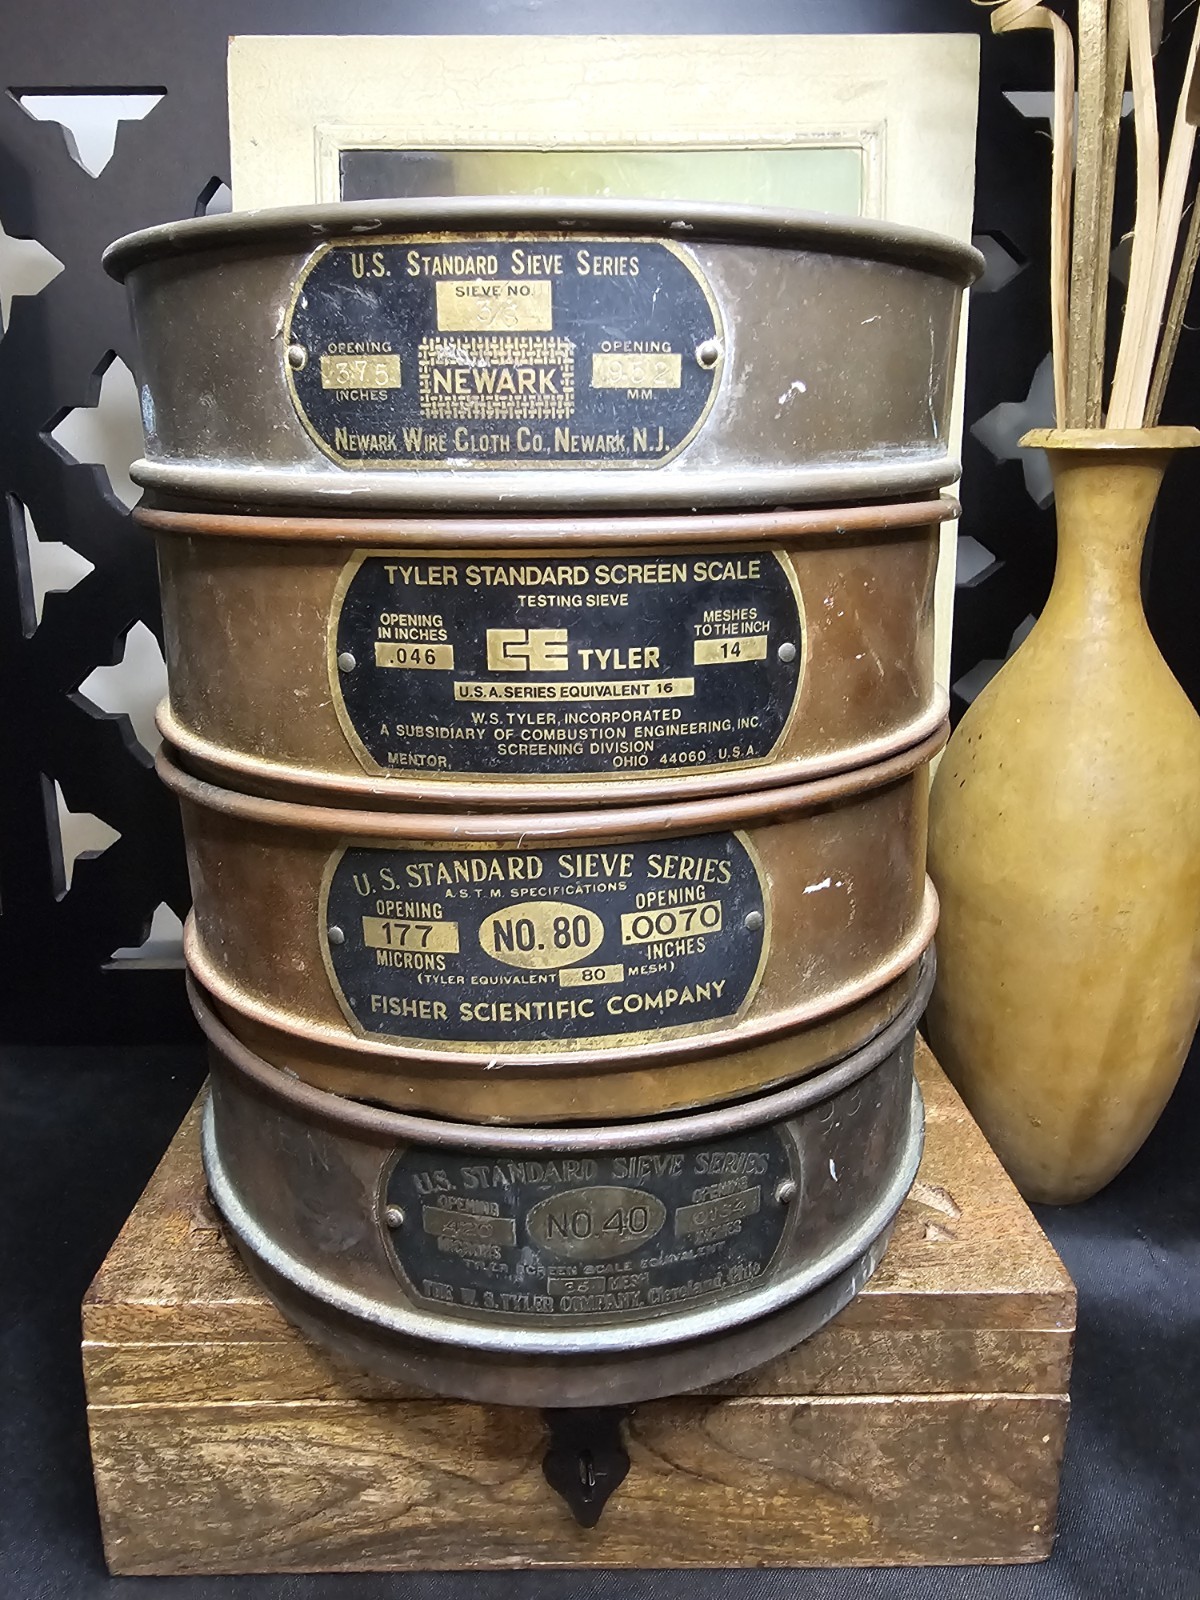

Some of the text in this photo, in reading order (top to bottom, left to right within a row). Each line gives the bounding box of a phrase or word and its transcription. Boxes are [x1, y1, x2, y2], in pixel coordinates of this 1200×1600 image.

[352, 249, 639, 278] U.S. STANDARD SIEVE SERIES
[455, 286, 501, 297] SIEVE
[327, 342, 392, 353] OPENING
[601, 340, 671, 352] OPENING
[433, 368, 557, 394] NEWARK
[335, 389, 388, 402] INCHES
[335, 427, 397, 452] NEWARK
[403, 427, 447, 452] WIRE
[455, 426, 510, 452] CLOTH
[633, 427, 670, 452] N.J.
[384, 560, 761, 586] TYLER STANDARD SCREEN SCALE
[518, 594, 629, 607] TESTING SIEVE
[380, 613, 443, 628] OPENING
[703, 608, 758, 622] MESHES
[377, 627, 448, 642] IN INCHES
[694, 620, 770, 636] TO THE INCH
[390, 647, 436, 665] .046
[578, 647, 660, 671] TYLER
[720, 642, 741, 658] 14
[504, 686, 557, 698] SERIES
[560, 684, 651, 698] EQUIVALENT
[657, 682, 673, 694] 16
[564, 708, 682, 724] INCORPORATED
[380, 724, 390, 736] A
[396, 725, 485, 740] SUBSIDIARY
[494, 729, 514, 741] OF
[521, 727, 627, 741] COMBUSTION
[634, 719, 735, 738] ENGINEERING,
[497, 741, 654, 756] SCREENING DIVISION
[613, 755, 648, 768] OHIO
[660, 751, 706, 764] 44060
[406, 856, 543, 888] STANDARD
[559, 853, 634, 878] SIEVE
[648, 853, 732, 884] SERIES
[511, 881, 627, 898] SPECIFICATIONS
[635, 885, 706, 909] OPENING
[376, 899, 443, 919] OPENING
[625, 904, 720, 941] .0070
[382, 922, 433, 948] 177
[493, 914, 591, 952] NO. 80
[647, 937, 706, 960] INCHES
[376, 950, 446, 971] MICRONS
[417, 960, 675, 985] (TYLER EQUIVALENT 80 MESH)
[371, 979, 726, 1022] FISHER SCIENTIFIC COMPANY
[460, 1158, 598, 1190] STANDARD
[612, 1154, 685, 1179] SIEVE
[694, 1152, 769, 1176] SERIES
[601, 1205, 650, 1237] 40
